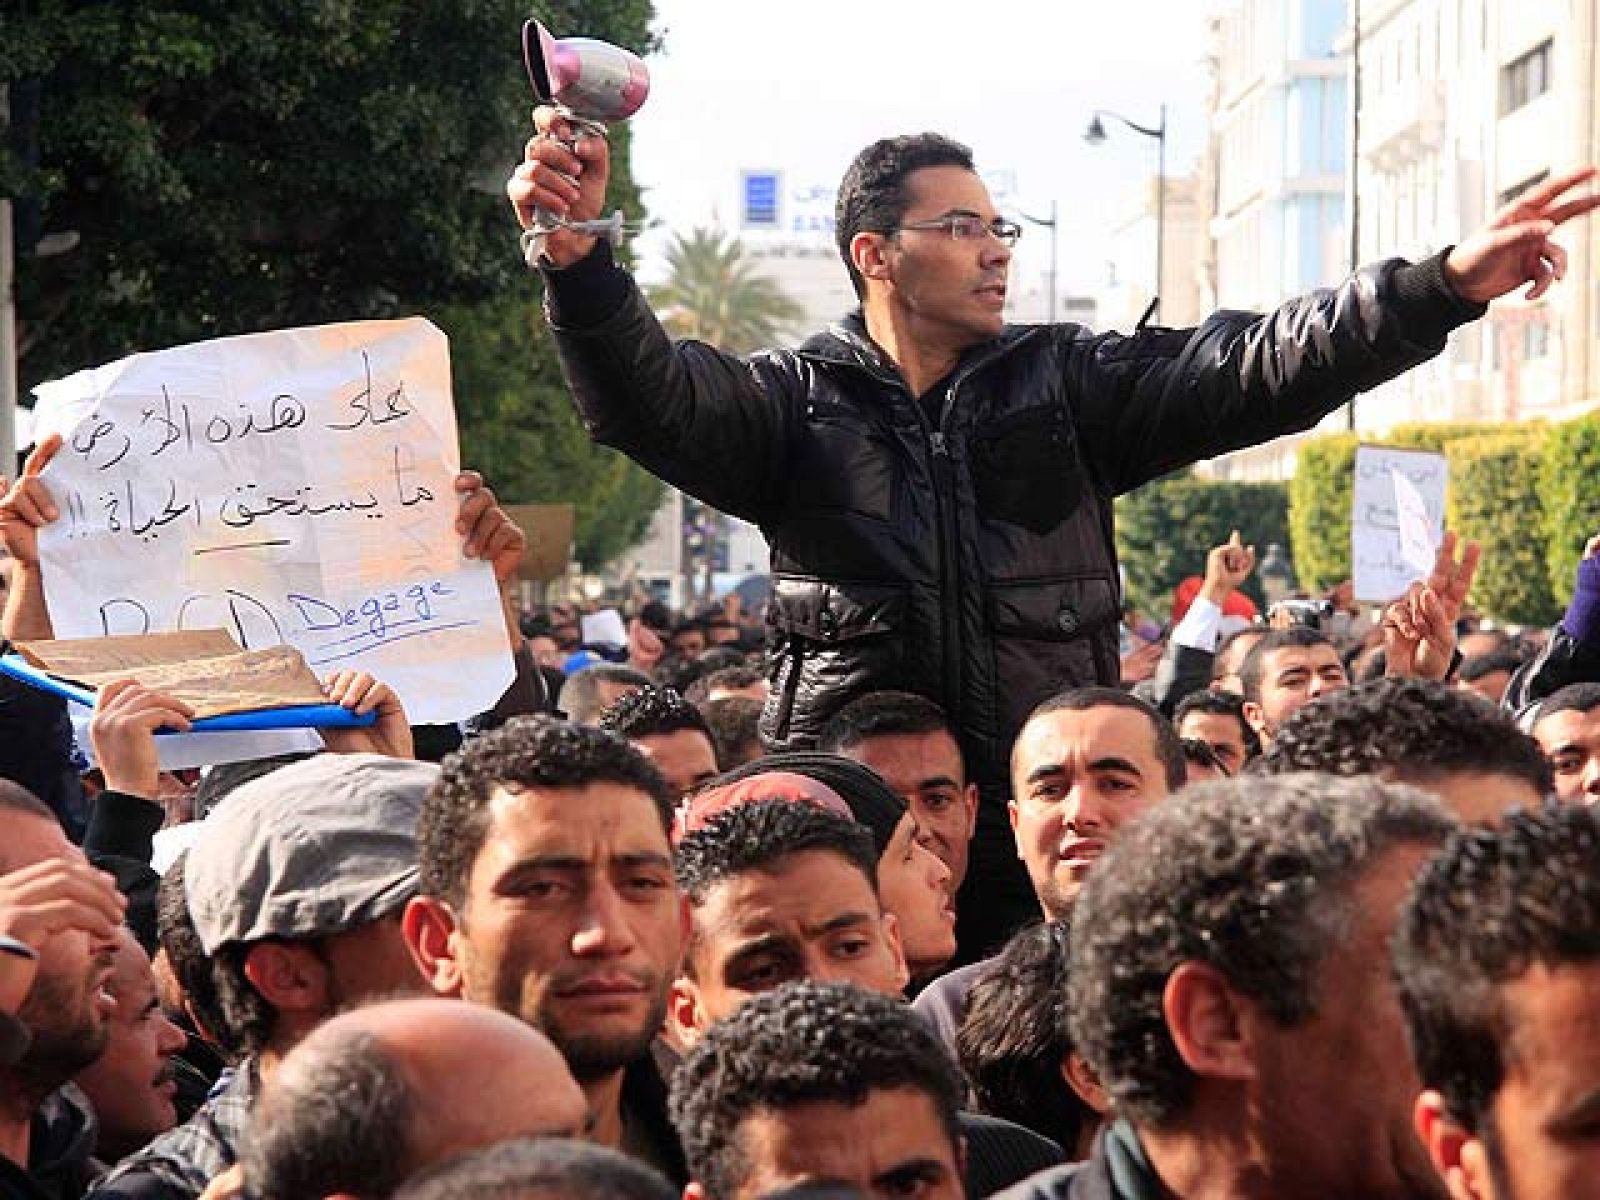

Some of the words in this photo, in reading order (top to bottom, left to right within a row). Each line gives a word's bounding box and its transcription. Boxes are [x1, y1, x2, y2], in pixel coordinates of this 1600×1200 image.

[205, 394, 306, 443] هذه
[325, 351, 410, 430] على
[219, 483, 384, 527] يستحق
[394, 443, 434, 506] ما
[100, 478, 201, 543] الحياة
